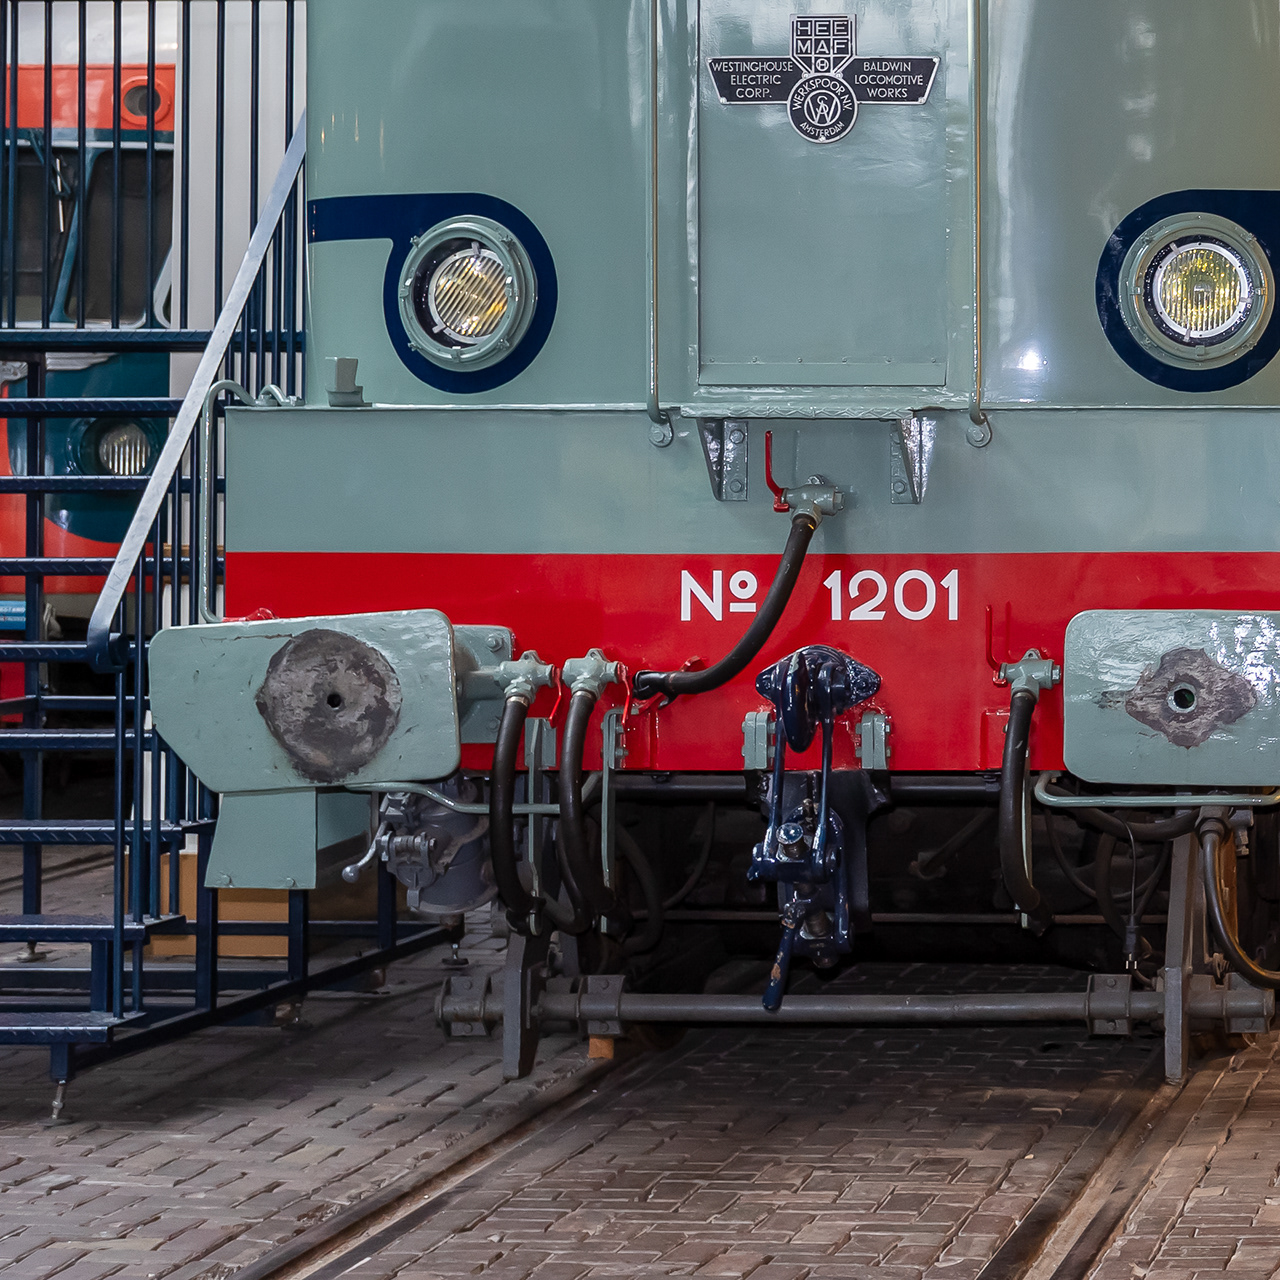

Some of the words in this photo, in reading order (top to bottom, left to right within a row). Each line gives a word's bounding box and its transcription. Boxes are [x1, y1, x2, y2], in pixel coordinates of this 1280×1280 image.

[712, 61, 793, 72] WESTINGHOUSE
[863, 61, 911, 72] BALDWIN
[731, 74, 781, 85] ELECTRIC
[854, 74, 923, 85] LOCOMOTIVE
[736, 87, 772, 98] CORP.
[792, 78, 845, 111] WERKSPOOR
[866, 87, 908, 98] WORKS
[800, 121, 845, 137] AMSTERDAM
[822, 569, 959, 621] 1201
